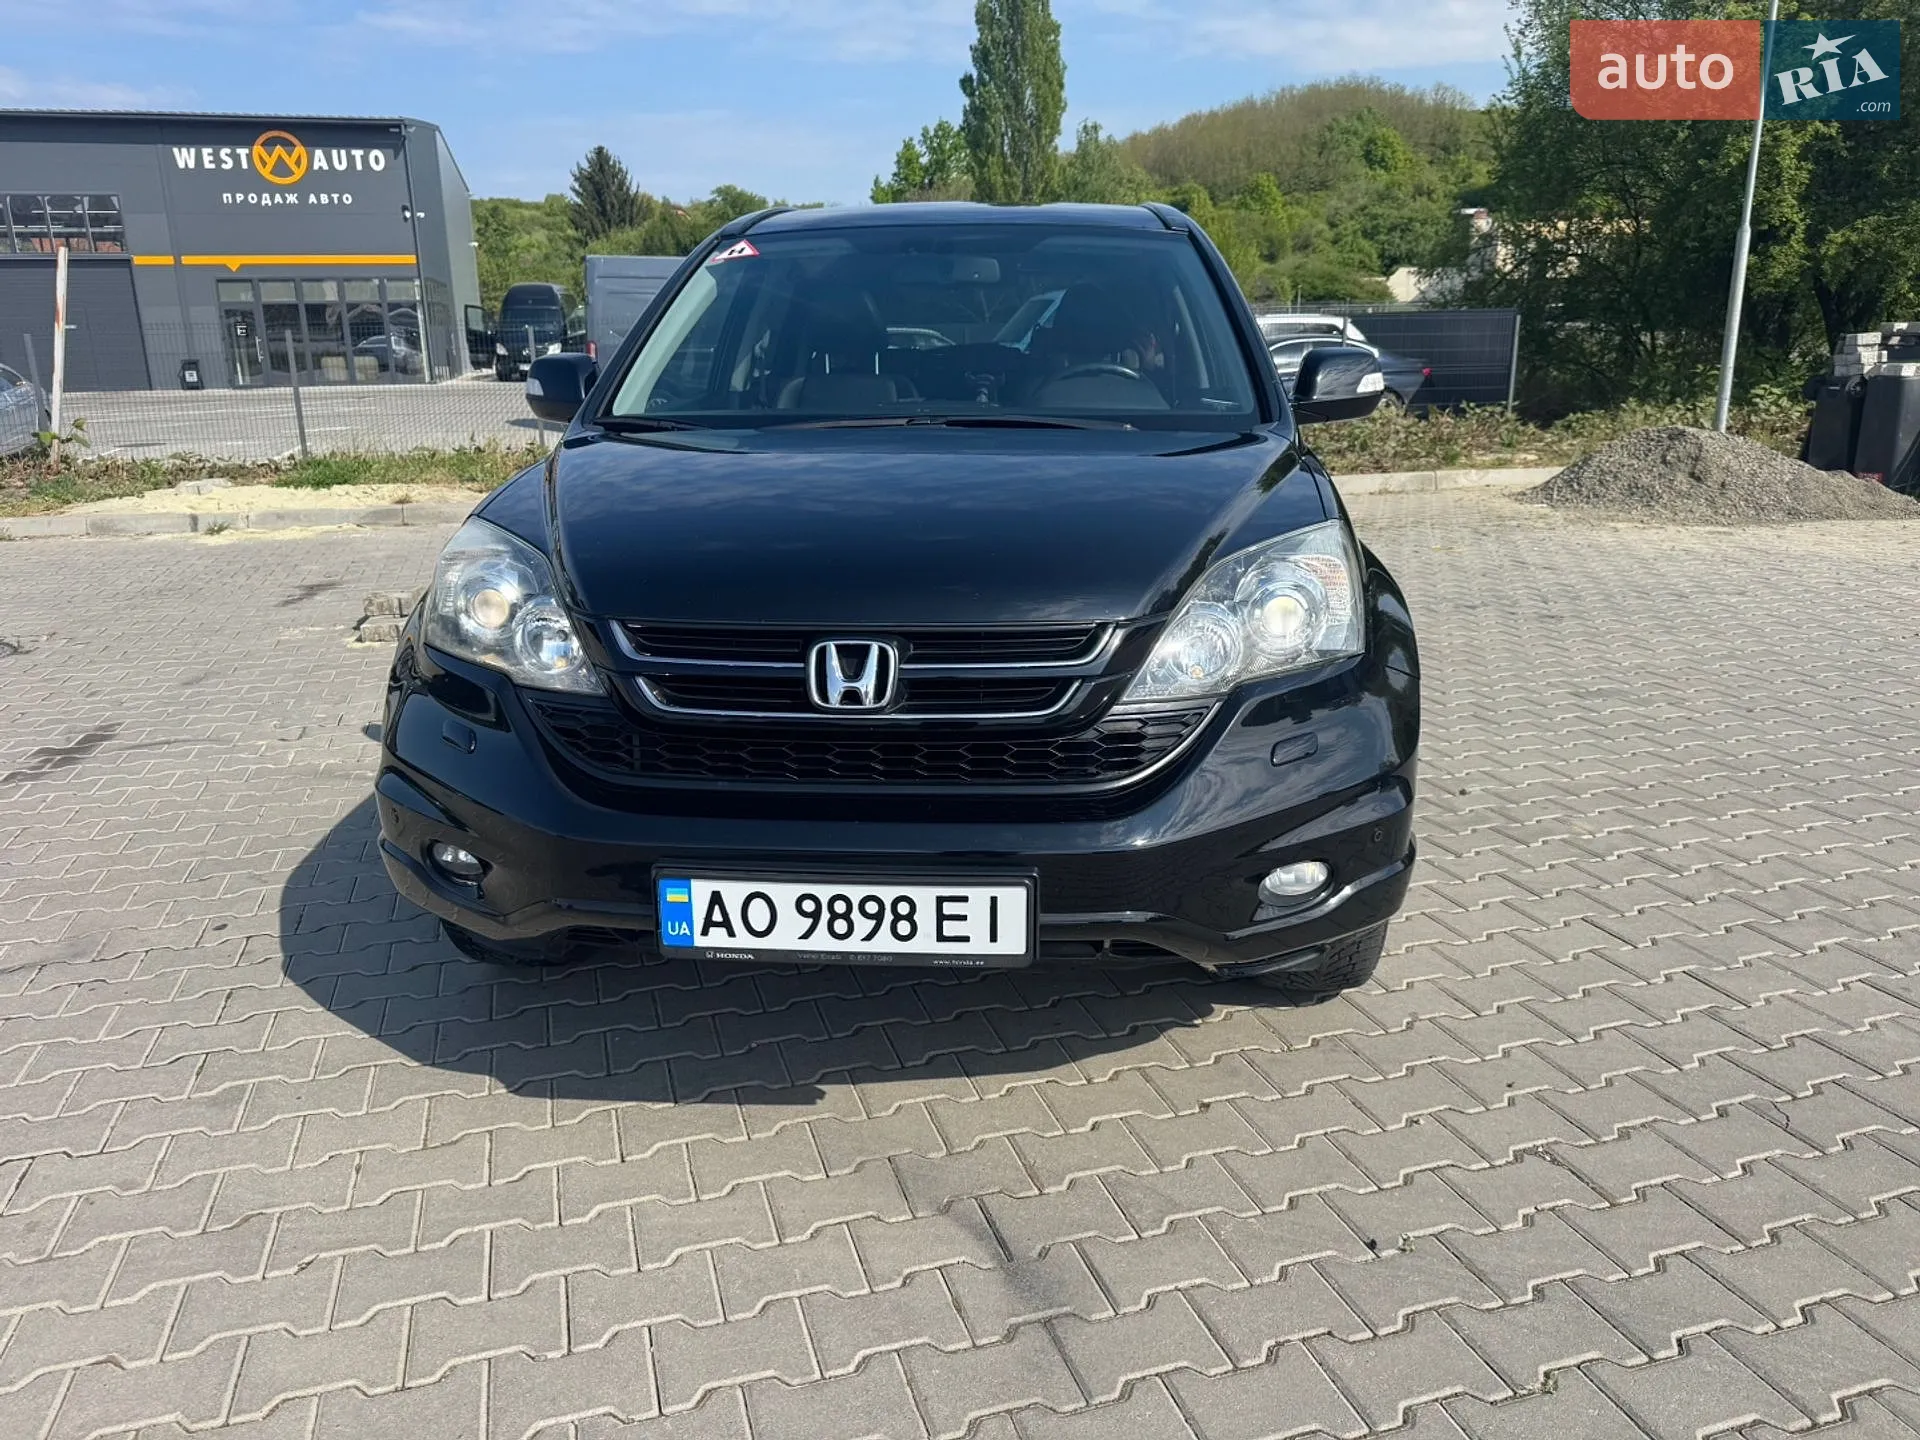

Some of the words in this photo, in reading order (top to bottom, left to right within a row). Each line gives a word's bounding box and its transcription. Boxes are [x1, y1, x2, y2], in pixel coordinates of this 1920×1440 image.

[172, 147, 249, 169] WEST
[312, 149, 386, 171] AUTO
[222, 192, 299, 207] ПРОДАЖ
[308, 193, 353, 204] АВТО
[667, 920, 691, 936] UA
[700, 890, 778, 938] AO
[795, 893, 918, 942] 9898
[935, 896, 998, 943] EI
[715, 951, 755, 960] HONDA
